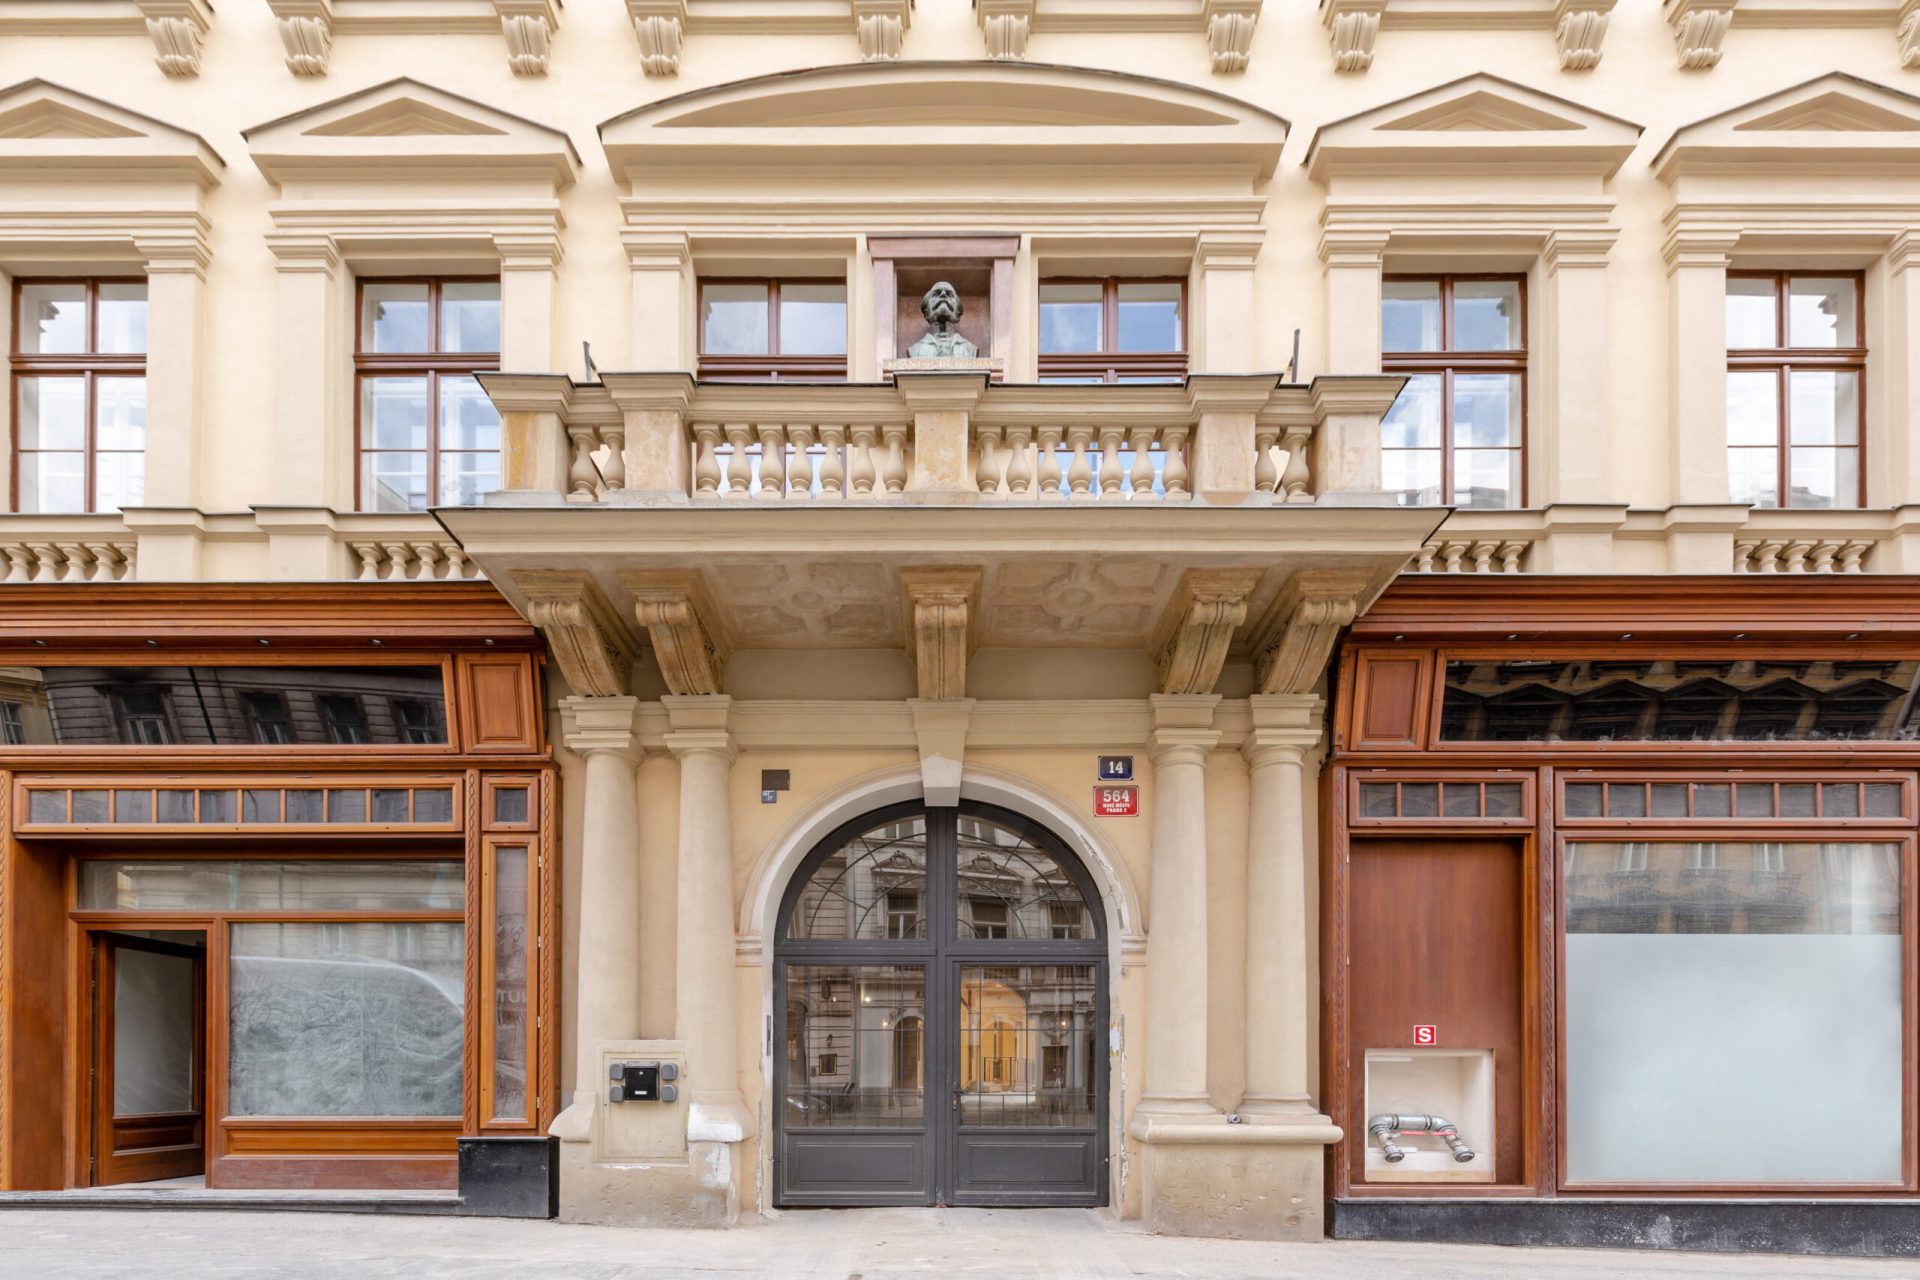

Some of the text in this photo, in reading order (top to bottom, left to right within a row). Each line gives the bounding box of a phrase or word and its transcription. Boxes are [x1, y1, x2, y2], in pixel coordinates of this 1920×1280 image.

[1109, 761, 1123, 774] 14
[1103, 789, 1130, 803] 564
[1418, 1028, 1432, 1042] S
